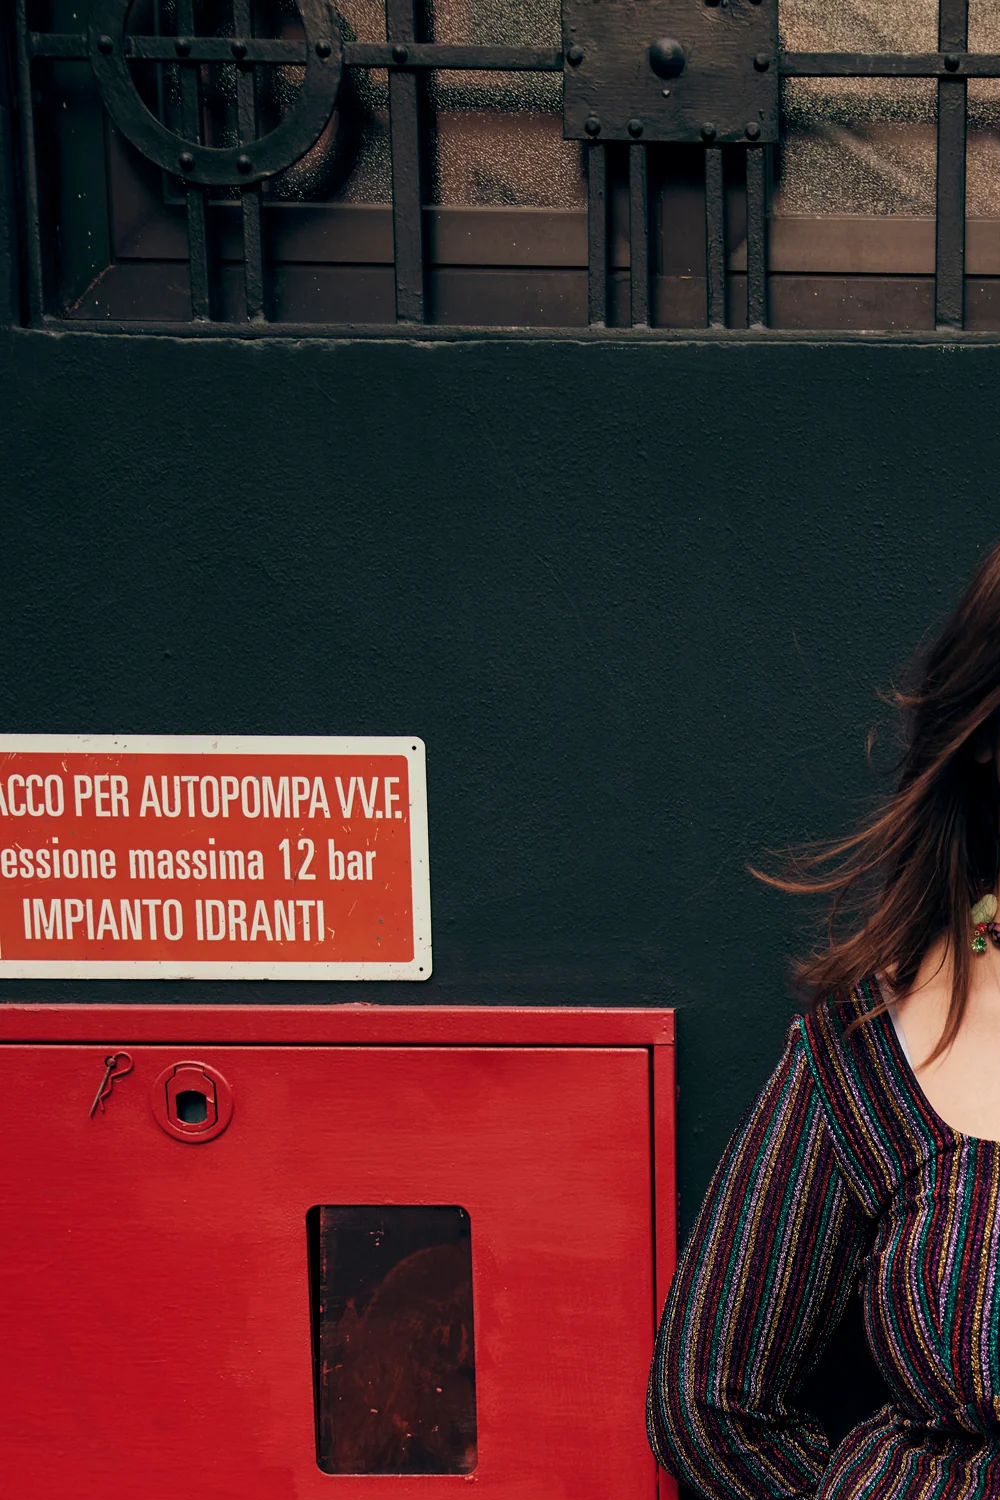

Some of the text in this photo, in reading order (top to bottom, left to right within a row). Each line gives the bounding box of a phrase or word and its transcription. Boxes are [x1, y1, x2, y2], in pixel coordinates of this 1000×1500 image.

[73, 774, 130, 817] PER
[139, 775, 331, 819] AUTOPOMPA
[1, 836, 377, 881] essione massima 12 bar
[22, 898, 325, 942] IMPIANTO IDRANTI
